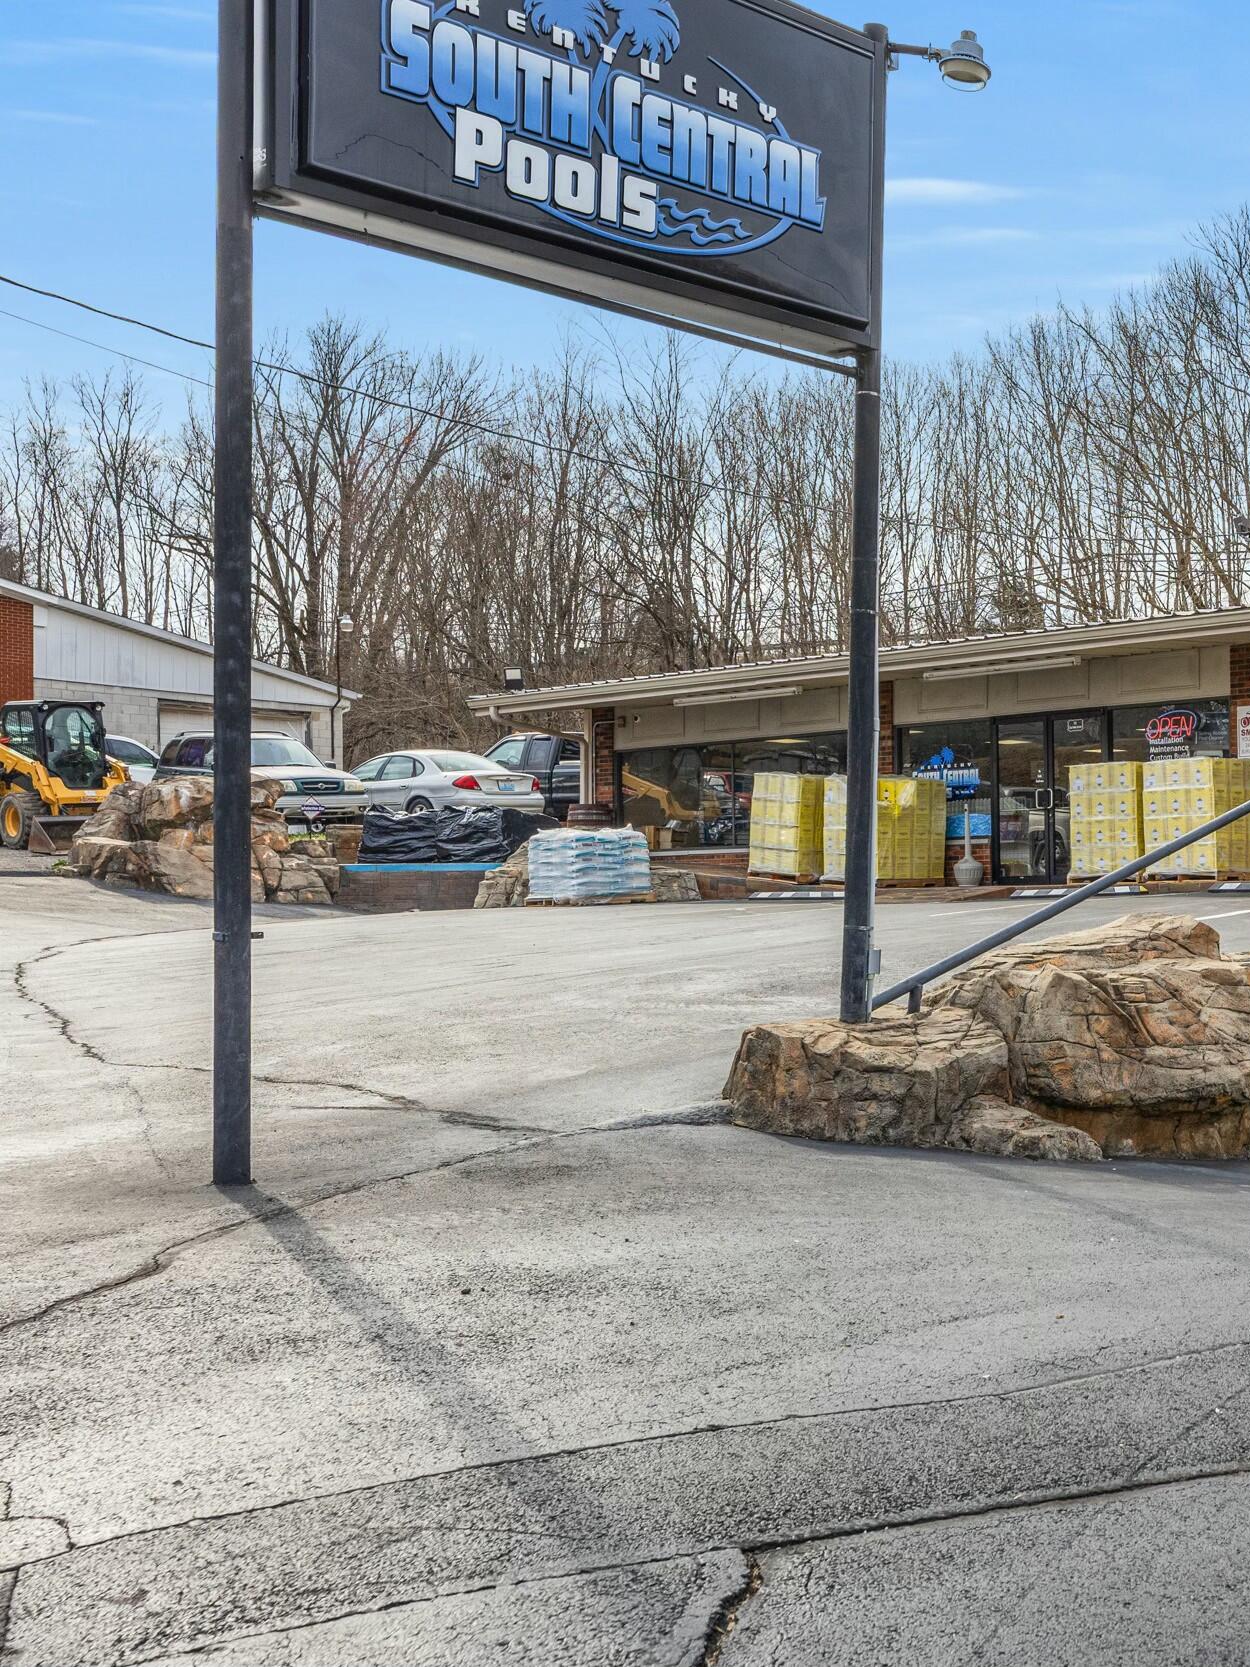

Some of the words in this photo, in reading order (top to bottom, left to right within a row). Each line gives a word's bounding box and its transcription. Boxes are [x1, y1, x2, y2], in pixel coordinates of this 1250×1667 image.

[389, 0, 591, 150] SOUTH
[613, 74, 824, 226] CENTRAL
[1146, 716, 1193, 739] OPEN
[1149, 745, 1189, 754] Maintenance
[1149, 754, 1173, 762] Custom
